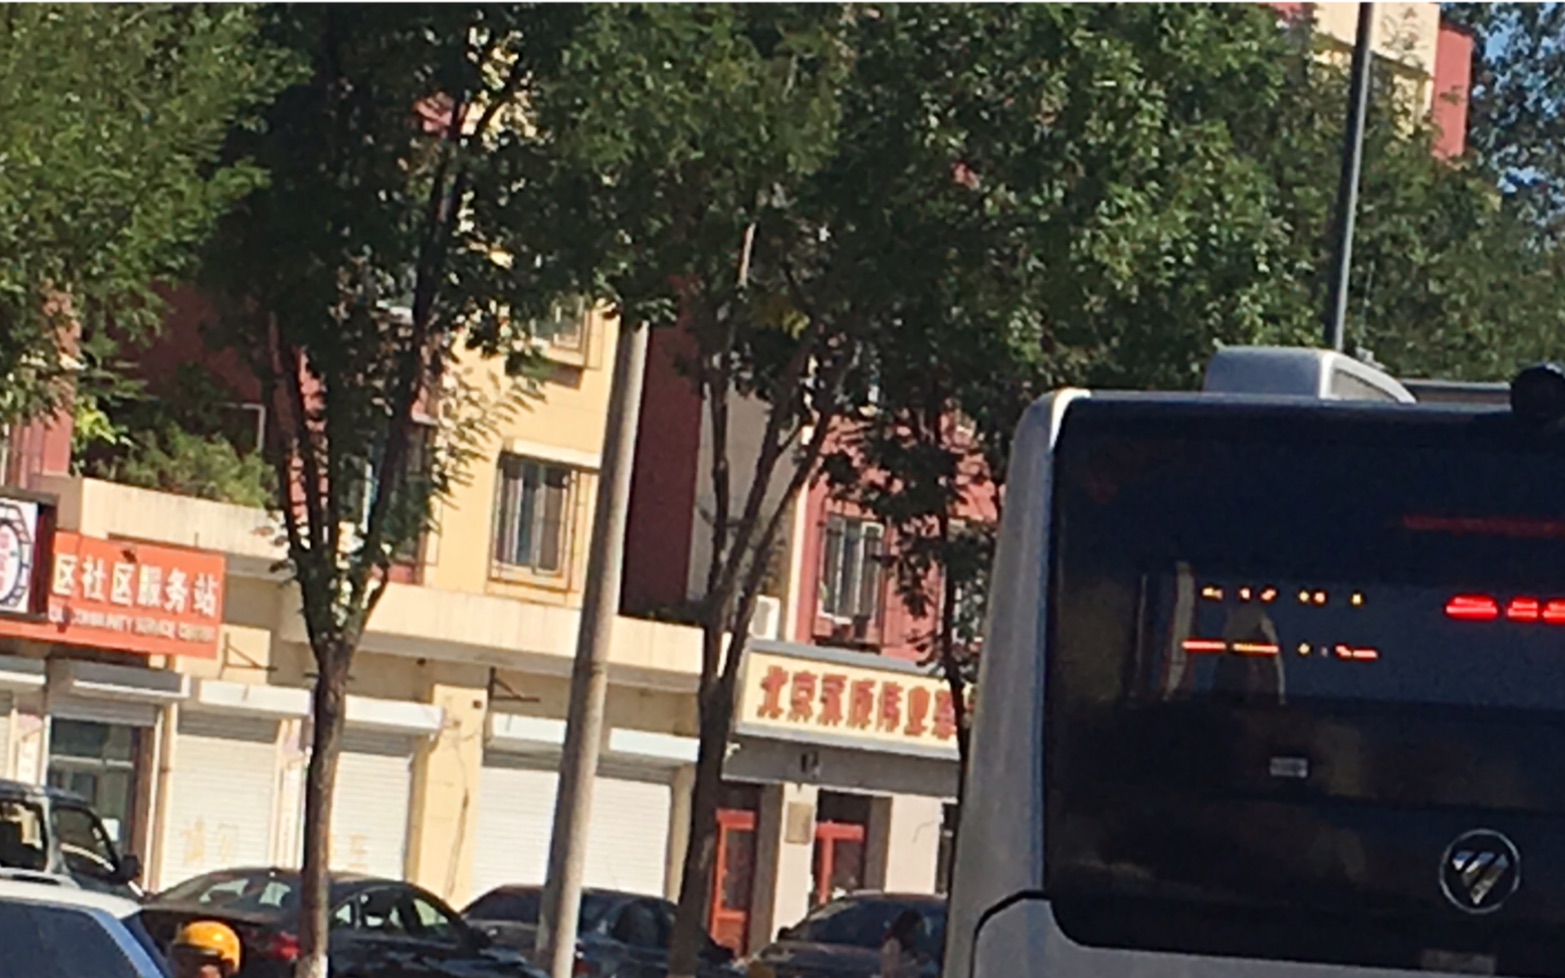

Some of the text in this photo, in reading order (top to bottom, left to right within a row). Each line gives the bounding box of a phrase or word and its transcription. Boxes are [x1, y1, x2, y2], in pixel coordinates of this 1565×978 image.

[52, 553, 219, 617] 区社区服务站
